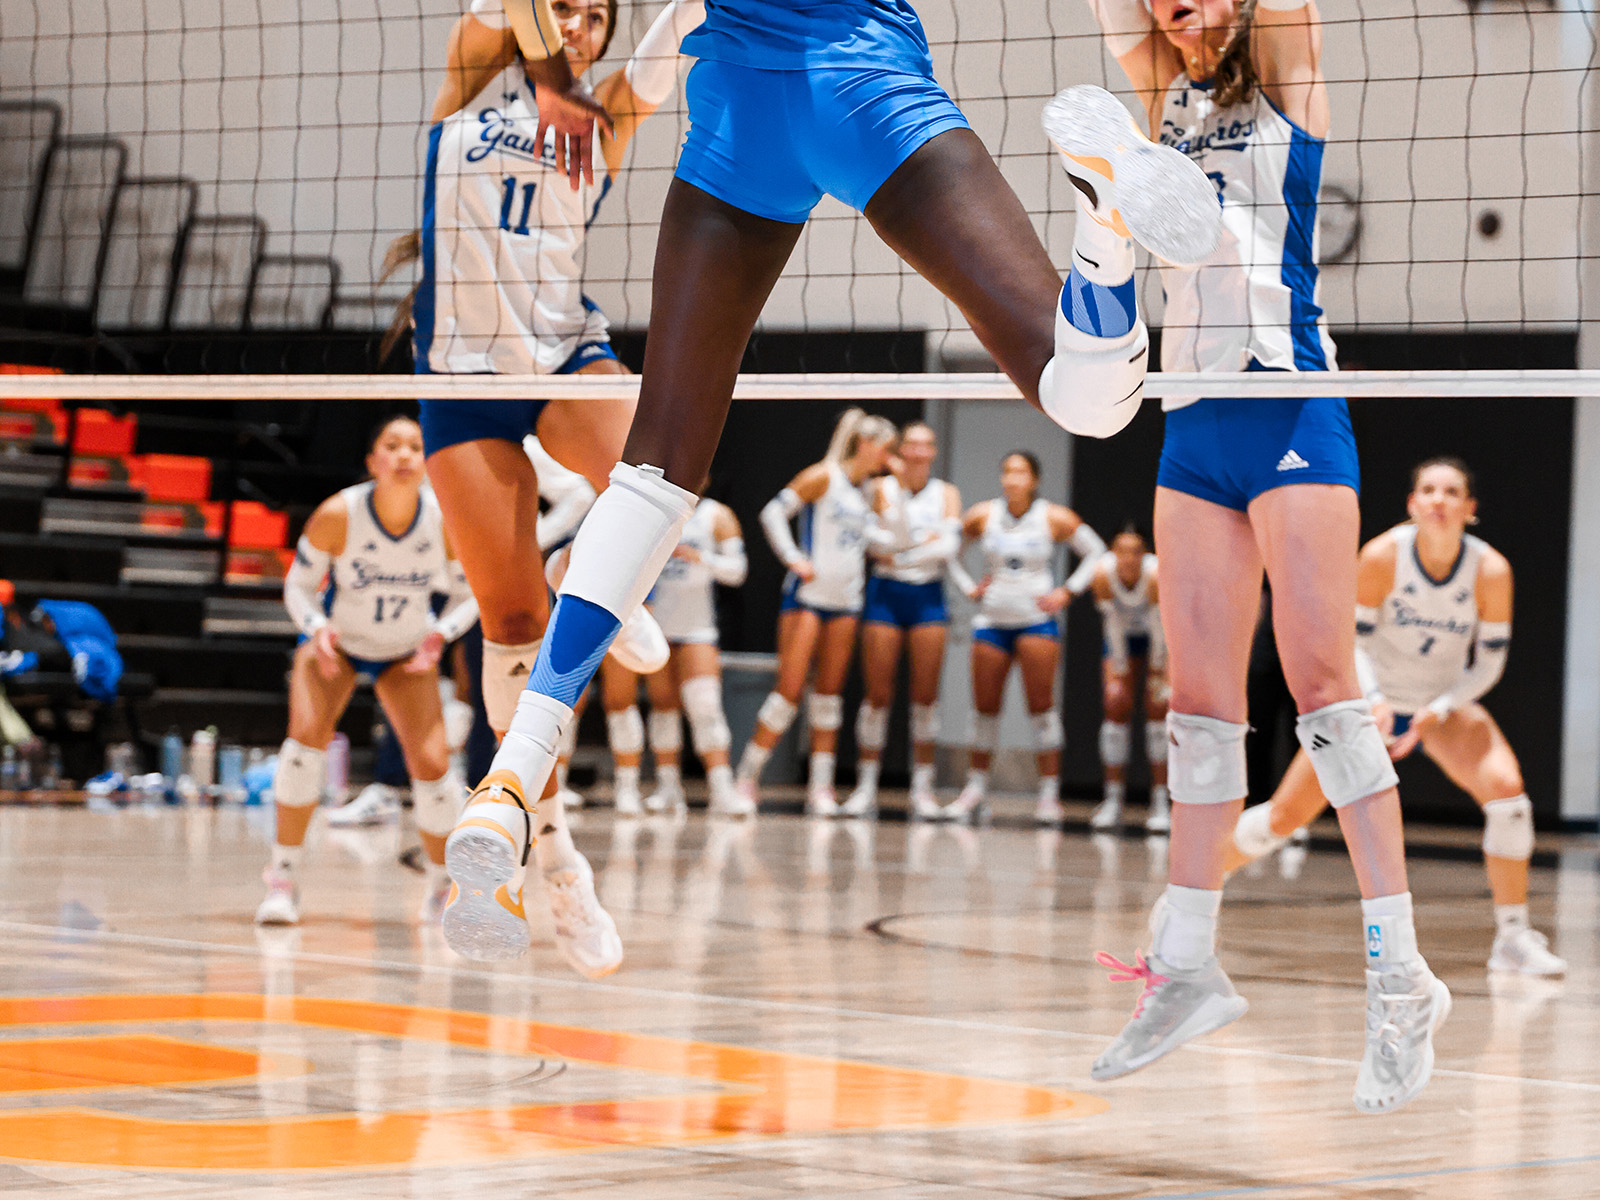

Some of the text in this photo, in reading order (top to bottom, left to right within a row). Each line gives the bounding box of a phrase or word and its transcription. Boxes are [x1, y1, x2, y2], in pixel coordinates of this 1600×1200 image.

[466, 106, 560, 163] Gauc
[500, 176, 537, 236] 11
[374, 596, 409, 623] 17
